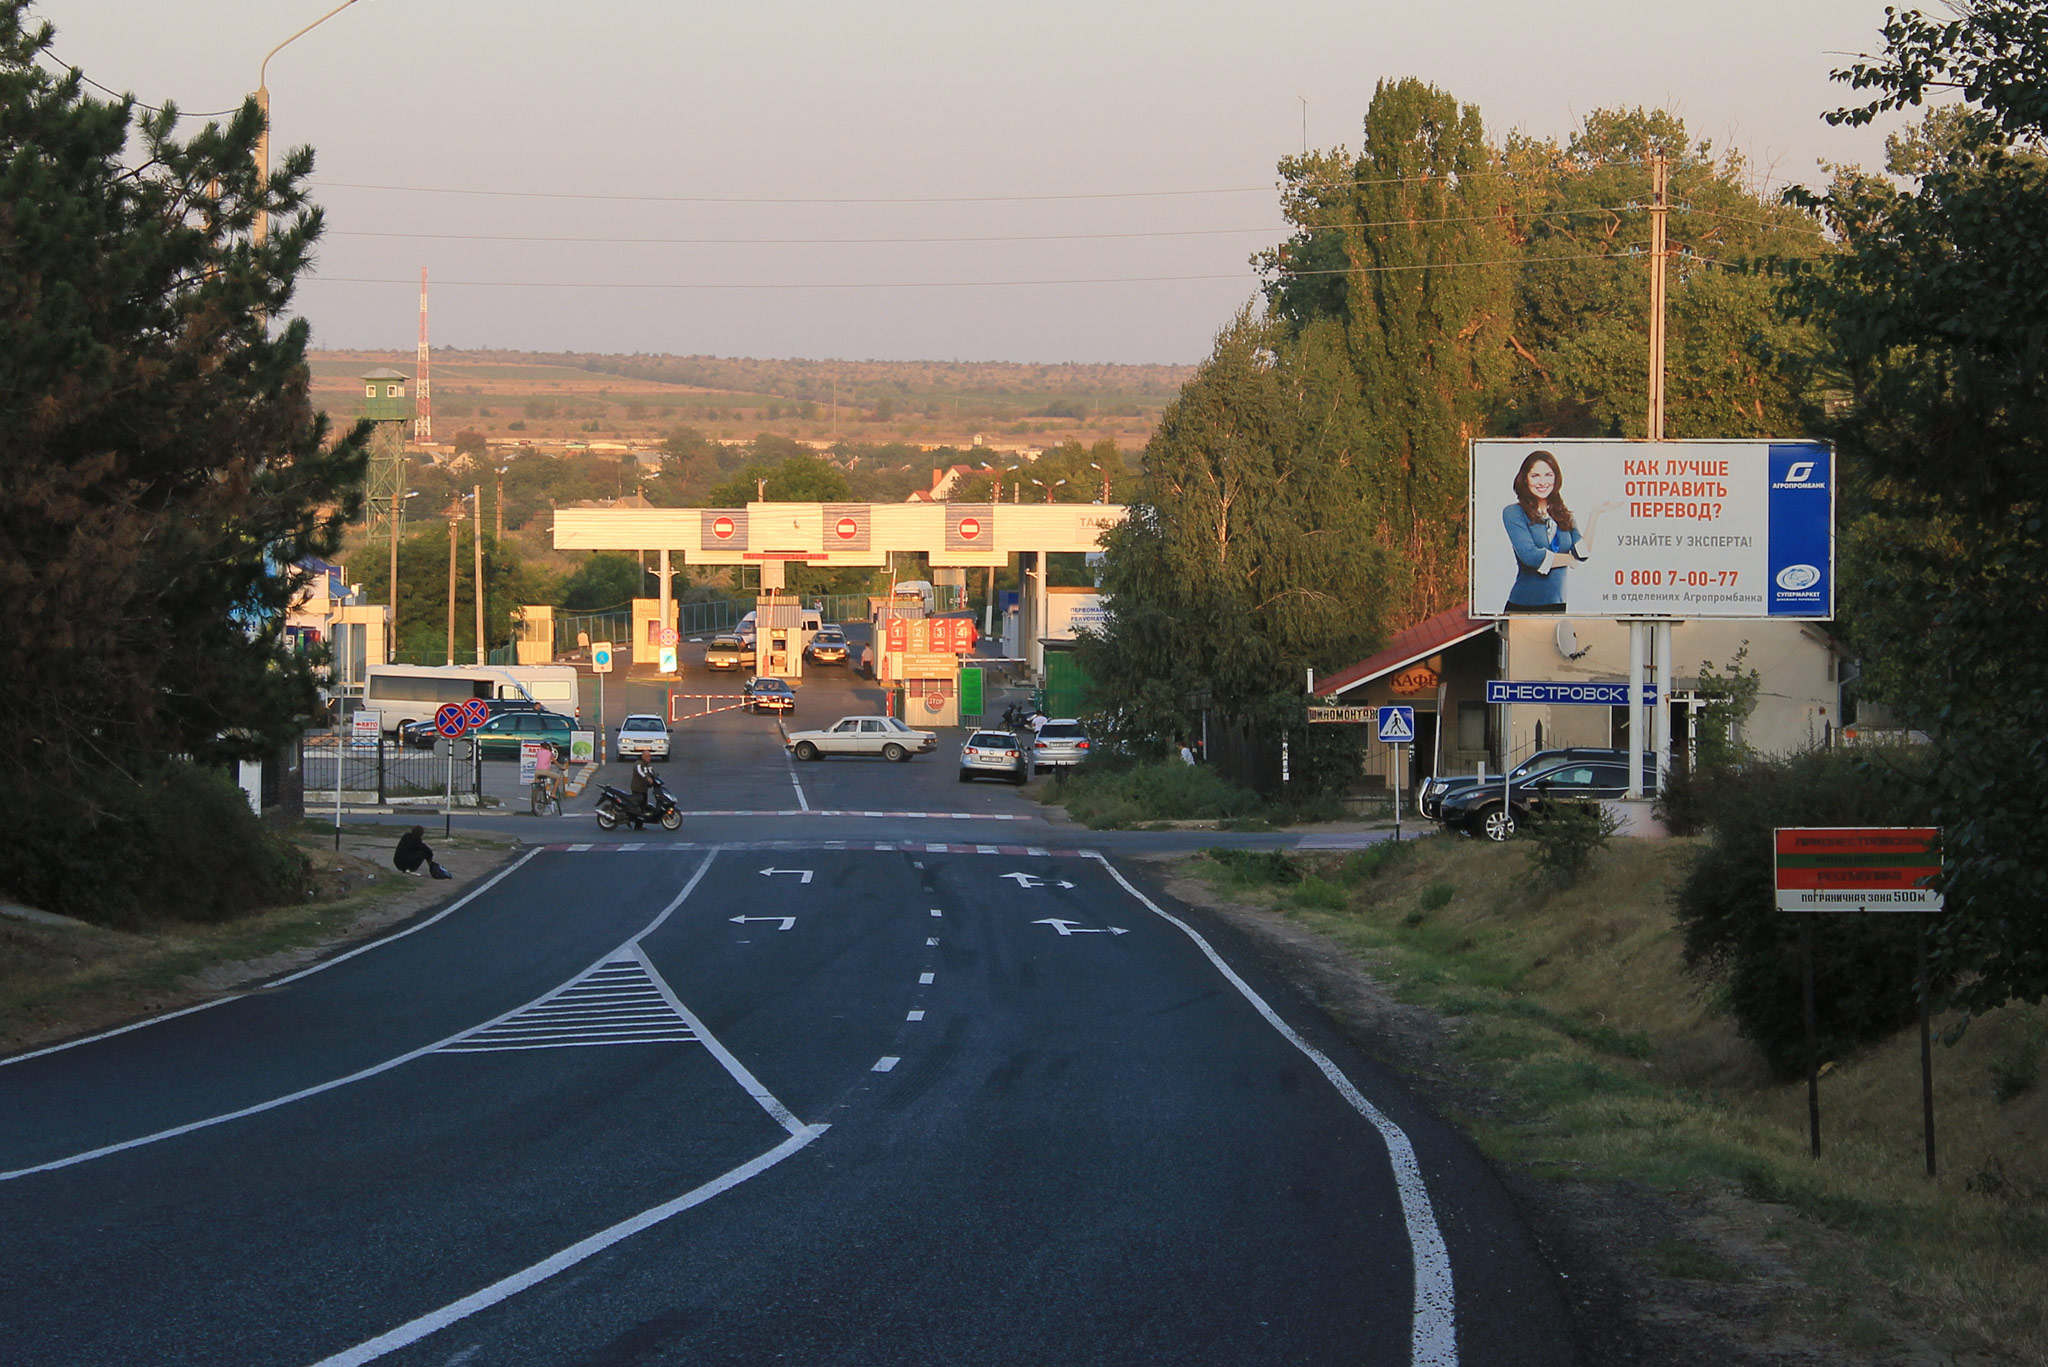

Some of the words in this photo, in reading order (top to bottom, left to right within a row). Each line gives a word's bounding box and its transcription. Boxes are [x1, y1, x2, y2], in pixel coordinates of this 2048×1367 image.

[1624, 460, 1659, 476] КАК
[1665, 460, 1729, 476] ЛУЧШЕ
[1625, 481, 1728, 497] ОТПРАВИТЬ
[1630, 502, 1722, 521] ПЕРЕВОД?
[1617, 533, 1672, 547] УЗНАЙТЕ
[1676, 535, 1683, 547] У
[1687, 536, 1752, 548] ЭКСПЕРТА!
[1614, 570, 1625, 586] 0
[1631, 570, 1662, 586] 800
[1668, 570, 1739, 587] 7-00-77
[1602, 593, 1609, 601] и
[1612, 593, 1618, 601] в
[1621, 593, 1680, 602] отделениях
[1683, 592, 1763, 604] Агропромбанка
[1391, 674, 1438, 687] КАФЕ
[1492, 685, 1624, 702] ДНЕСТРОВСК
[1801, 894, 1866, 903] ПОГРАНИЧНАЯ
[1868, 893, 1892, 903] ЗОНА
